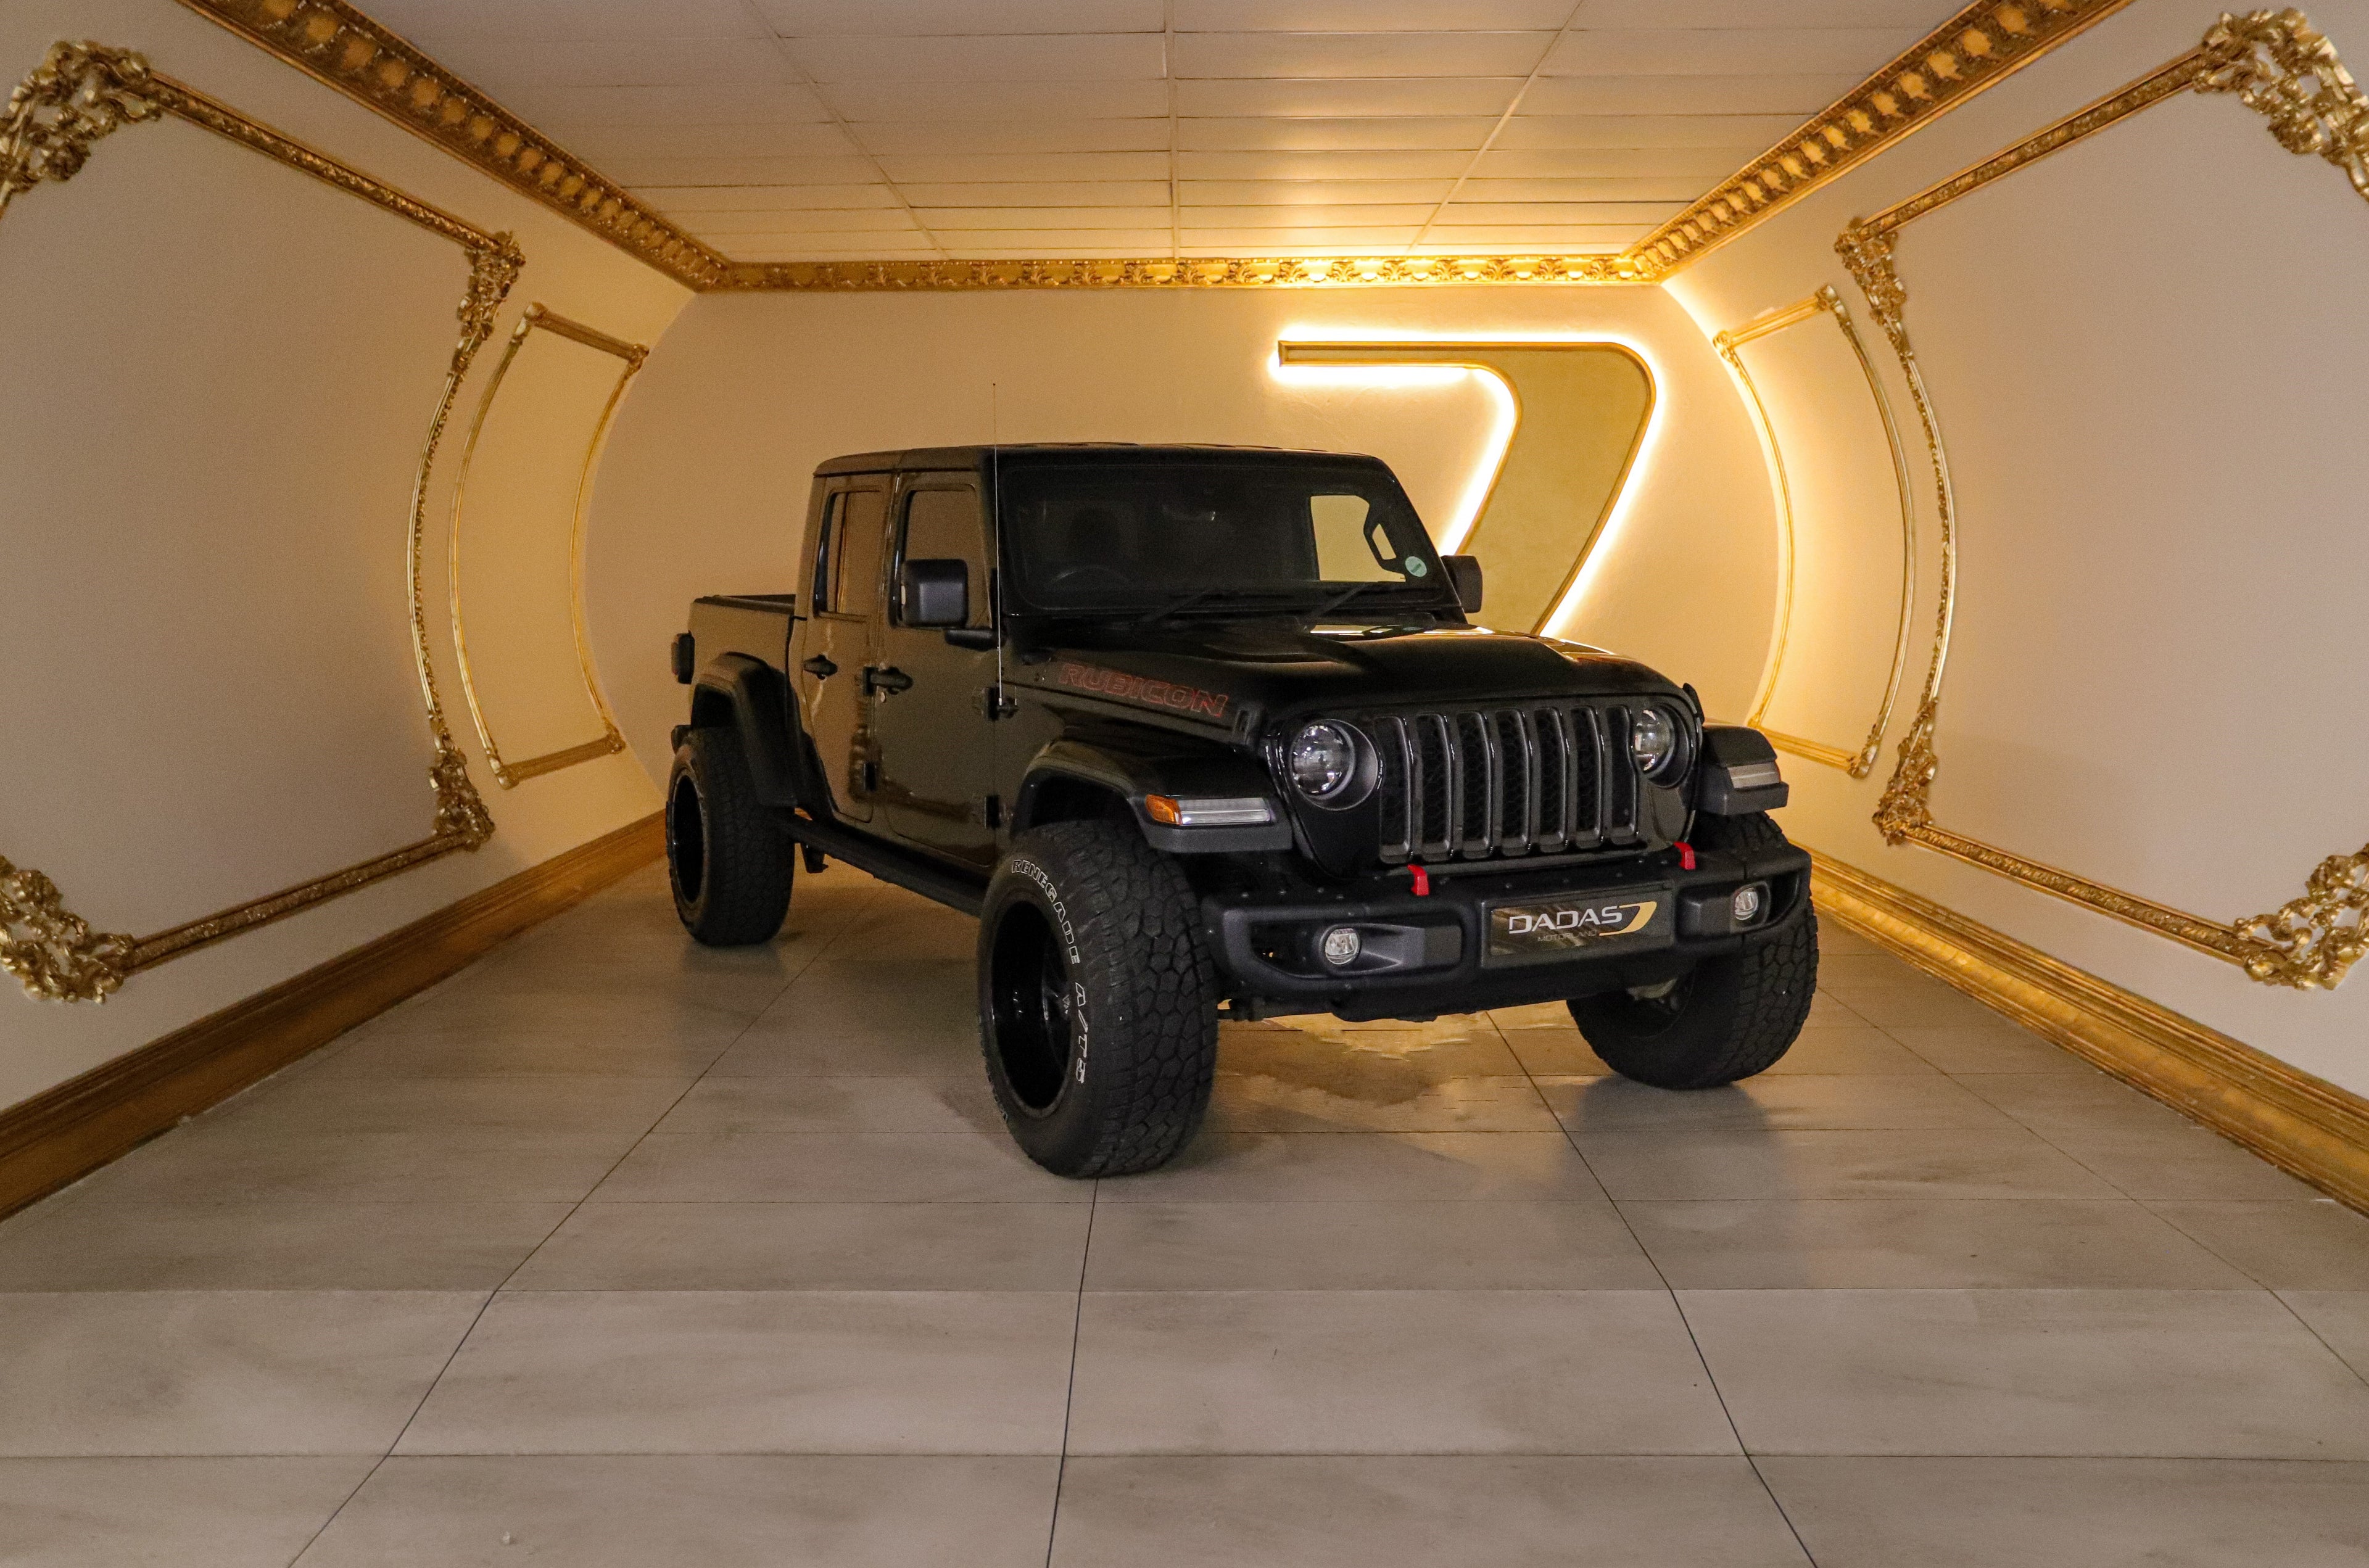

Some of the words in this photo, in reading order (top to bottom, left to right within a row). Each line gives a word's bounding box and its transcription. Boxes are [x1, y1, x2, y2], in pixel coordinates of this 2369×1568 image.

[1060, 662, 1228, 717] RUBICON
[1012, 860, 1080, 963] RENEGADE
[1509, 906, 1623, 934] DADAS
